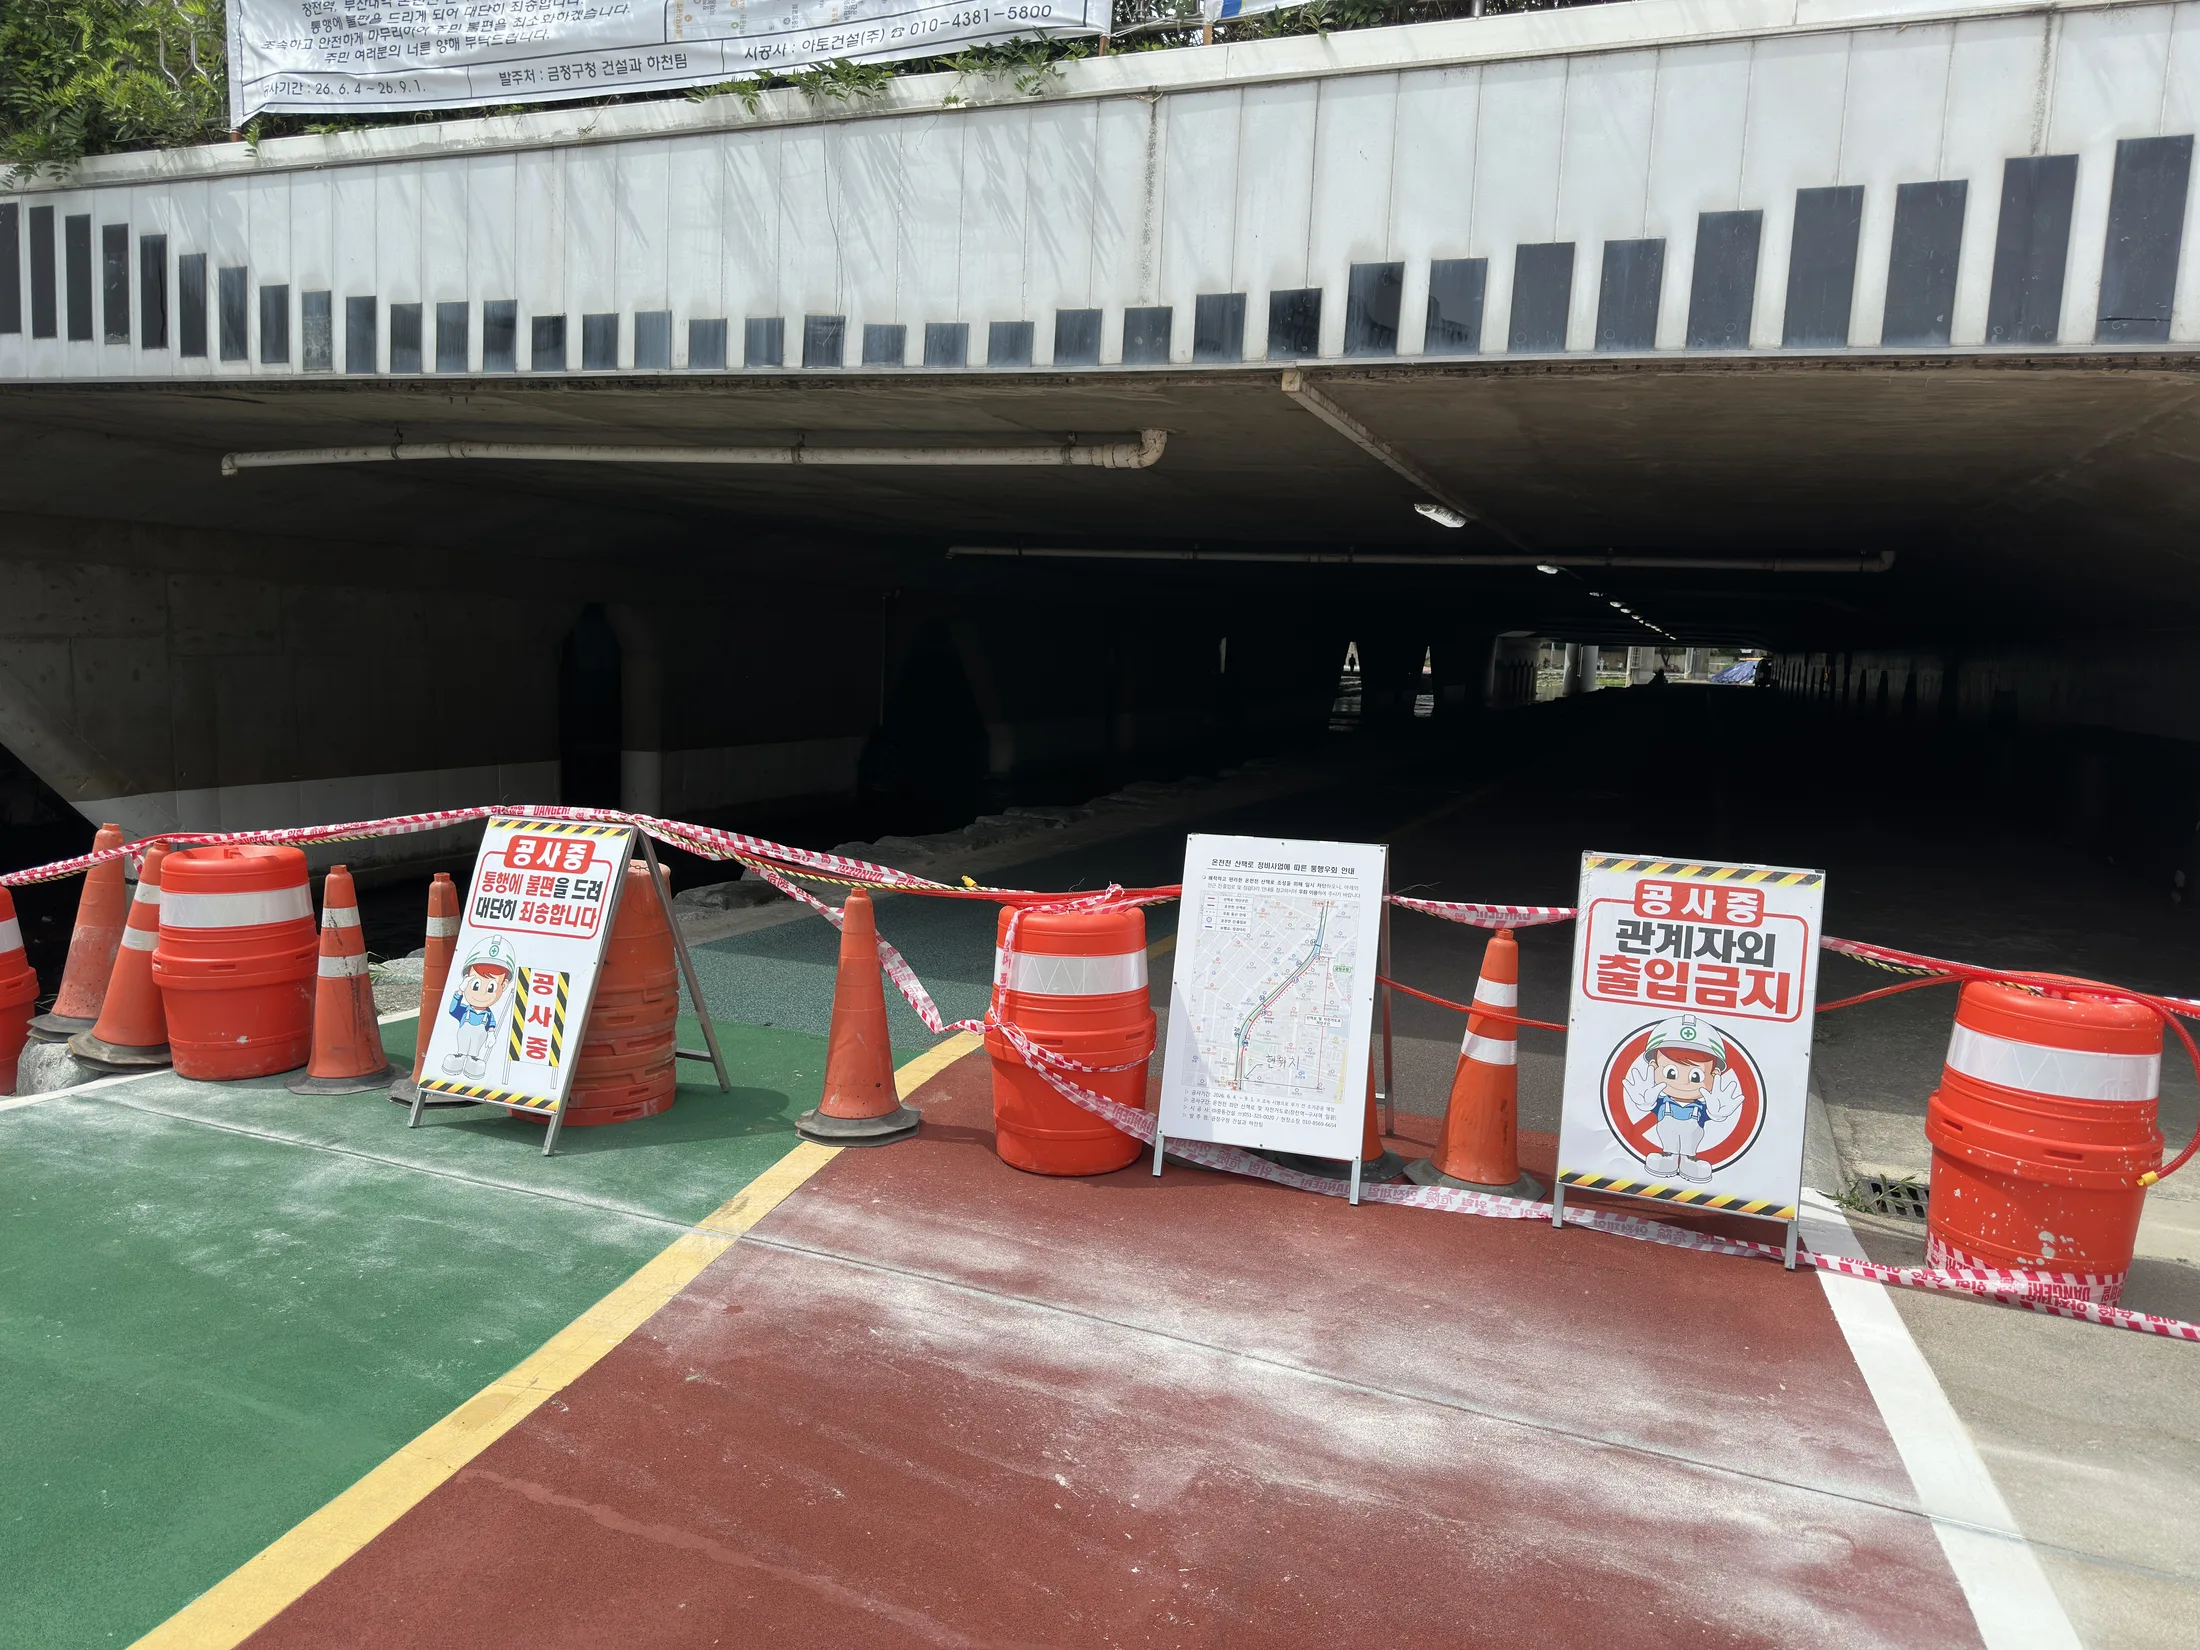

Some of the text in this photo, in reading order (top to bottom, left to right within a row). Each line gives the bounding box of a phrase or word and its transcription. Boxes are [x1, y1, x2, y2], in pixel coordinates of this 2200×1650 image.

[302, 1, 337, 17] 장전역,
[311, 20, 343, 34] 통행에
[387, 9, 427, 24] 드리게
[433, 8, 459, 20] 되어
[464, 3, 505, 17] 대단히
[319, 32, 364, 49] 안전하게
[466, 20, 507, 33] 불편을
[513, 4, 630, 27] 최소화하겠습니다.
[744, 43, 786, 61] 시공사
[802, 28, 885, 53] 아토건설(주)
[909, 4, 1052, 36] 010-4381-5800
[325, 29, 550, 64] 주민 여러분의 너른 양해 부탁드립니다.
[499, 69, 536, 87] 발주처
[547, 62, 597, 82] 금정구청
[602, 57, 642, 77] 건설과
[647, 53, 688, 72] 하천팀
[512, 839, 587, 871] 공사중
[1341, 867, 1355, 875] 안내
[481, 870, 603, 903] 통행에 불편을 드려
[1641, 884, 1759, 923] 공사중
[475, 896, 597, 930] 대단히 죄송합니다
[1614, 919, 1777, 968] 관계자외
[1596, 952, 1792, 1016] 출입금지
[525, 973, 554, 1060] 공사중
